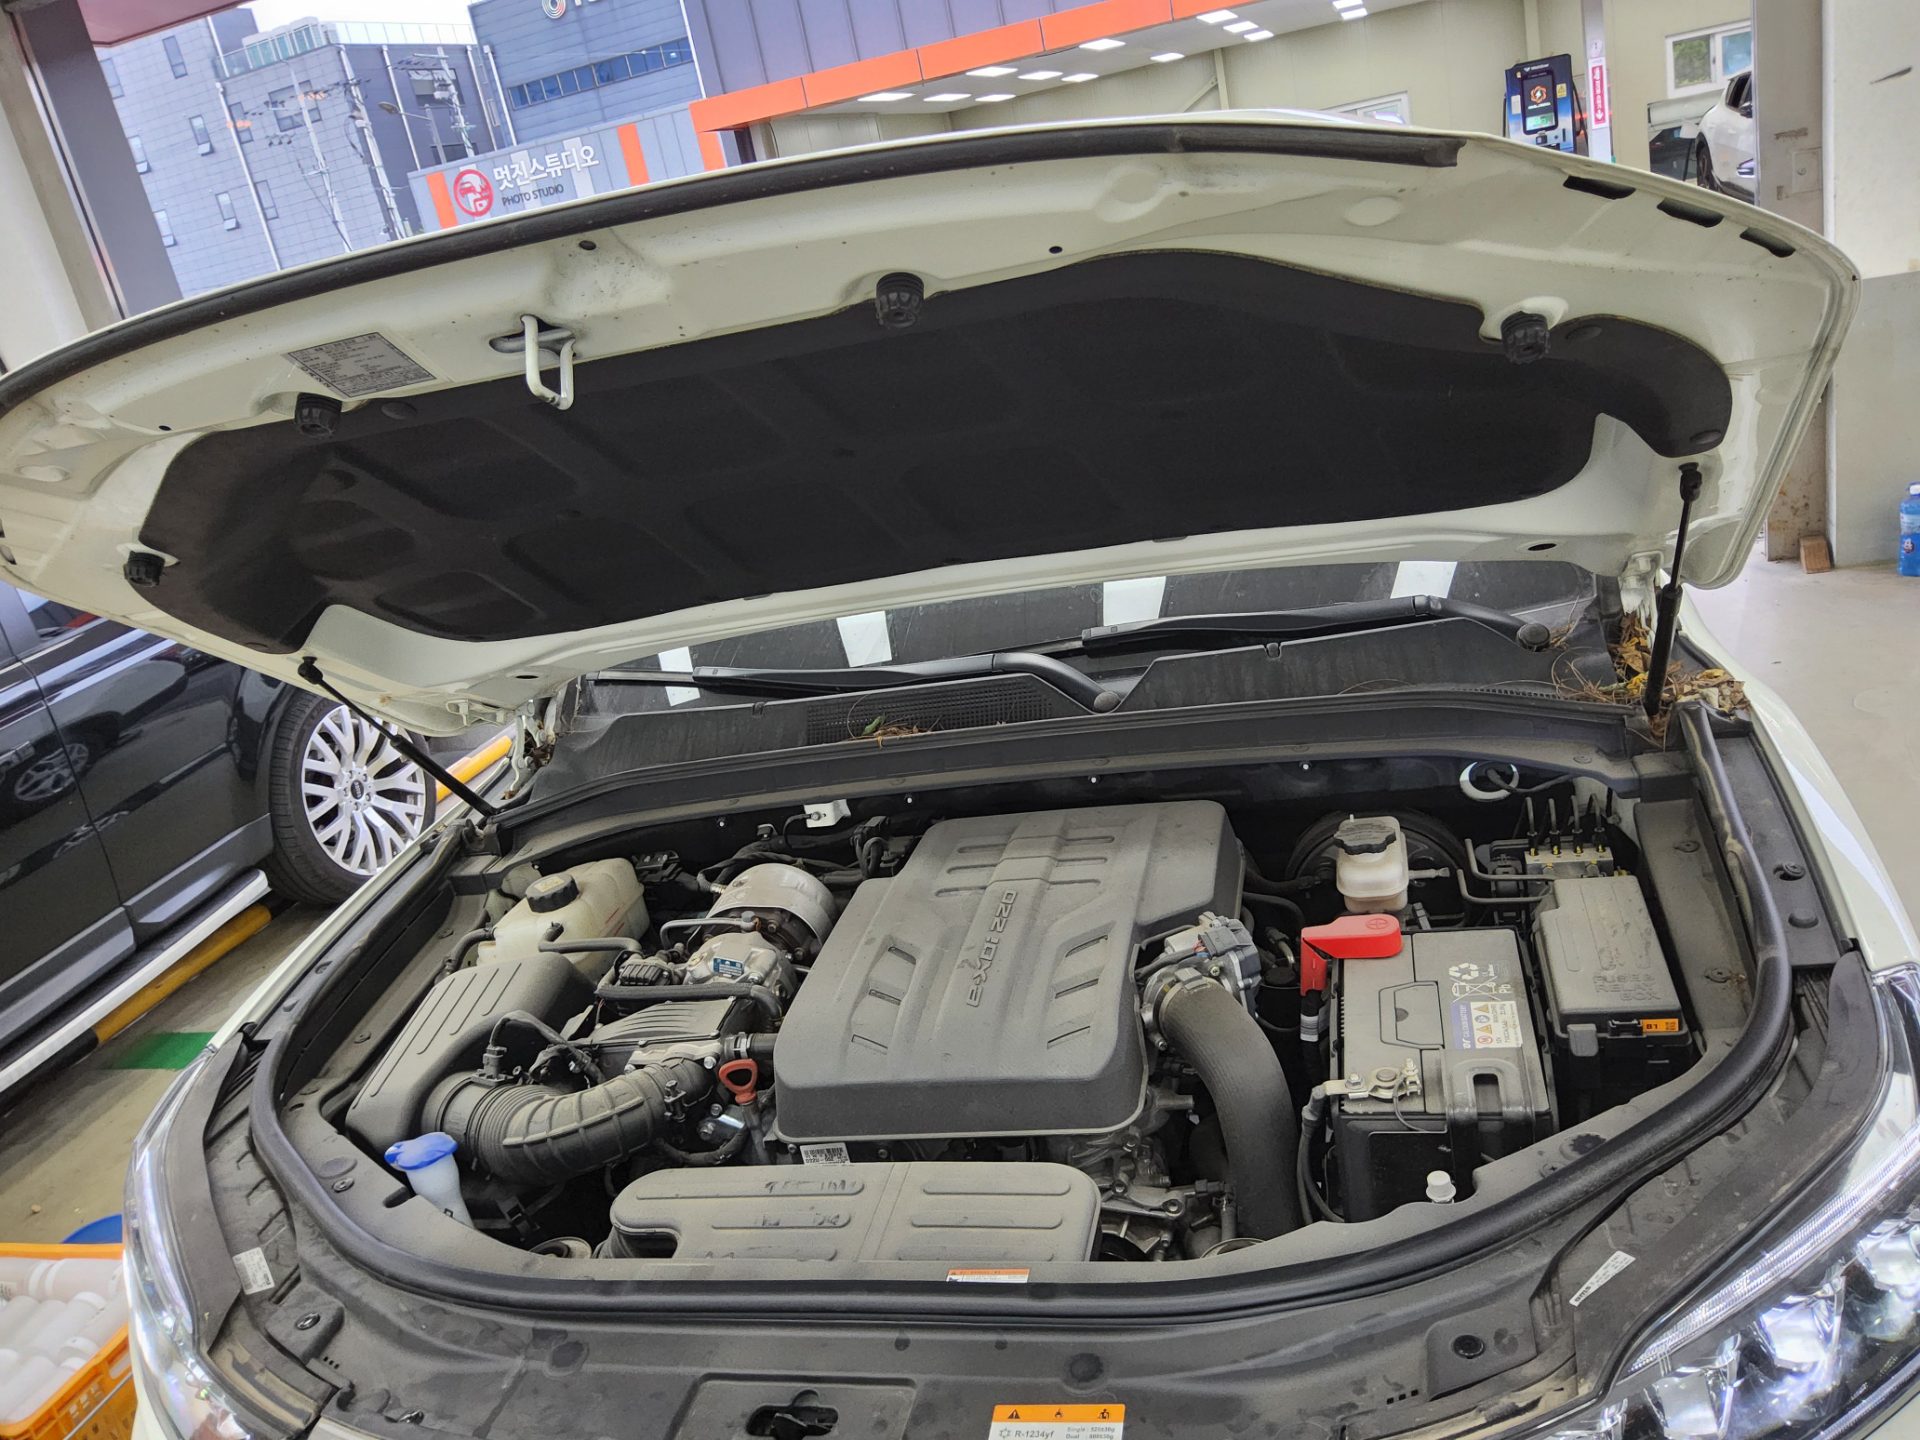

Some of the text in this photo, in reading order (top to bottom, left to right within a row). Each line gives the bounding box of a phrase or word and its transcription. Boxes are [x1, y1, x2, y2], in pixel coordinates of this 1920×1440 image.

[493, 145, 600, 191] 멋진스튜디오
[502, 184, 564, 207] PHOTO STUDIO
[1015, 1430, 1055, 1439] R-1234yf
